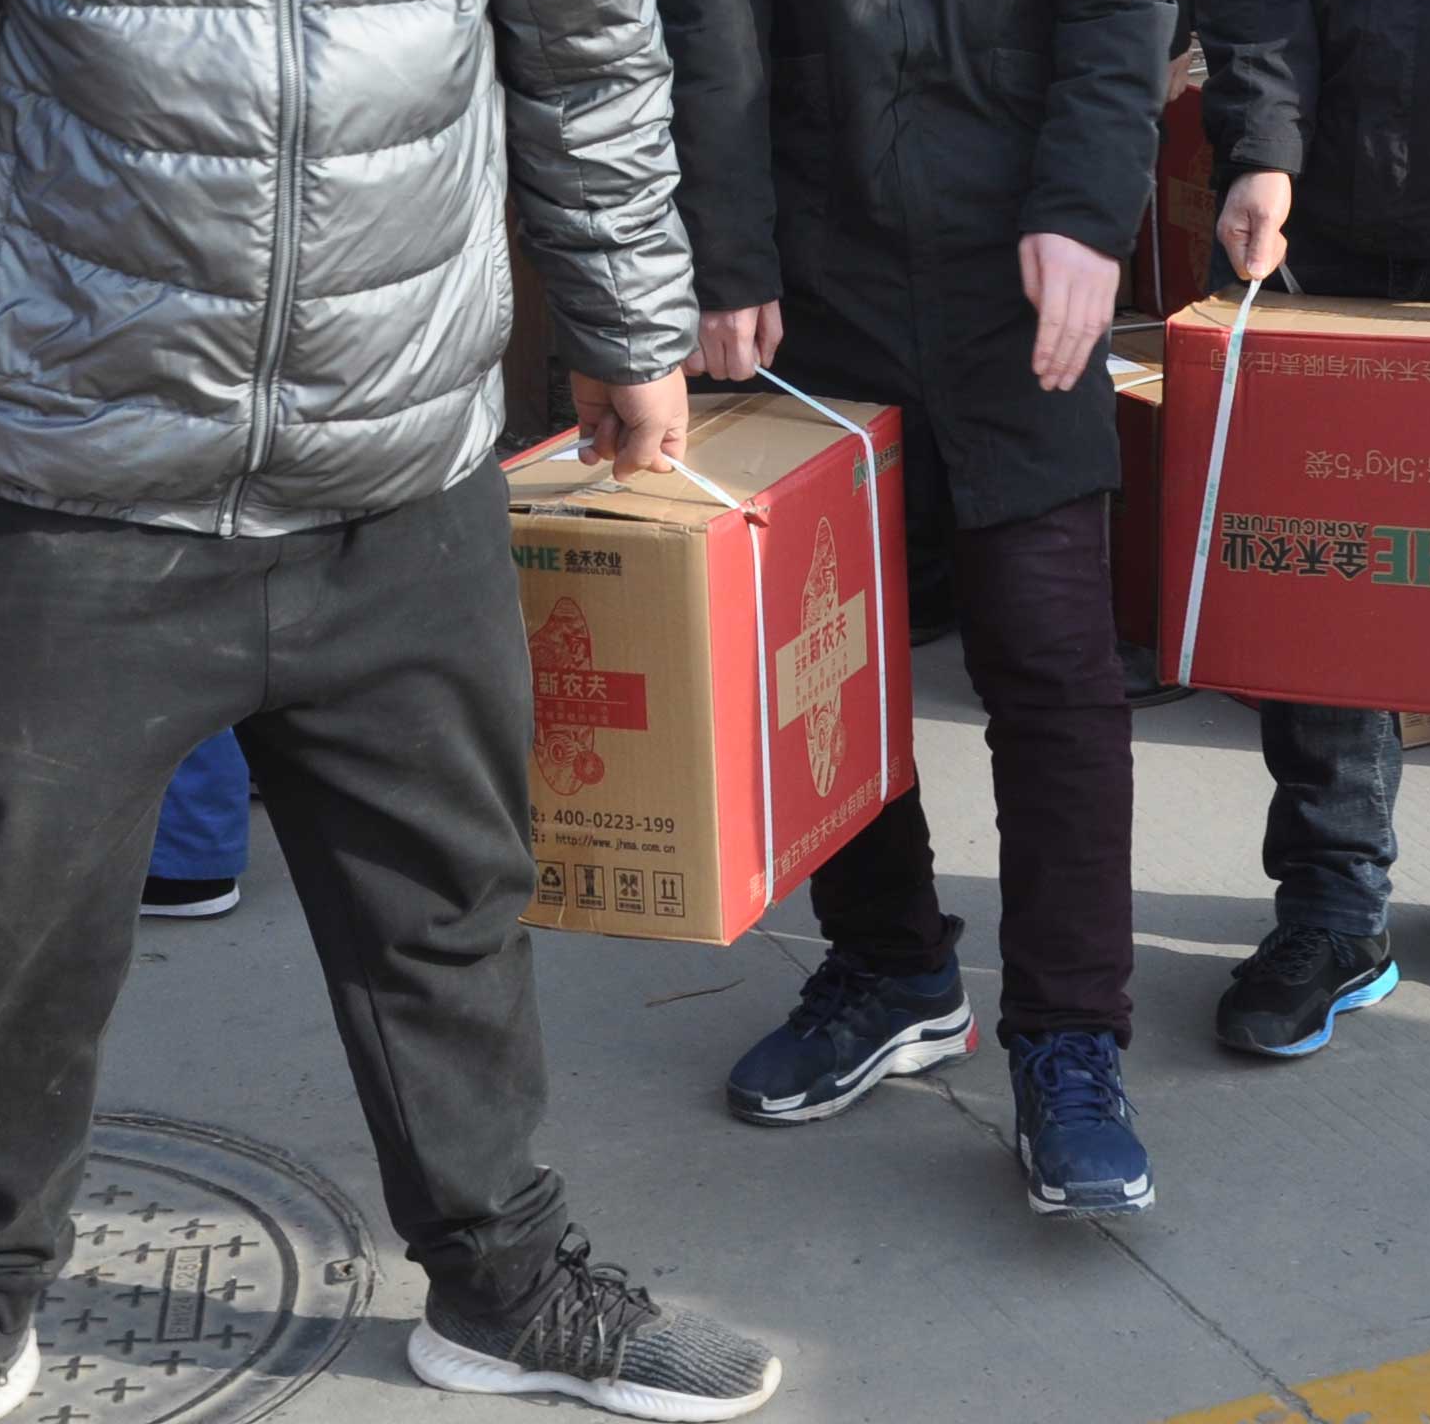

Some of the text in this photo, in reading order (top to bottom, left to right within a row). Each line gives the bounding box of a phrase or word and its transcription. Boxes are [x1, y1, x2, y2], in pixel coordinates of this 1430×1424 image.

[1223, 513, 1368, 538] AGRICULTURE
[564, 547, 622, 569] 金禾农业
[1221, 531, 1369, 580] 金禾农业
[538, 672, 608, 699] 新农夫
[553, 809, 676, 834] 400-0223-199
